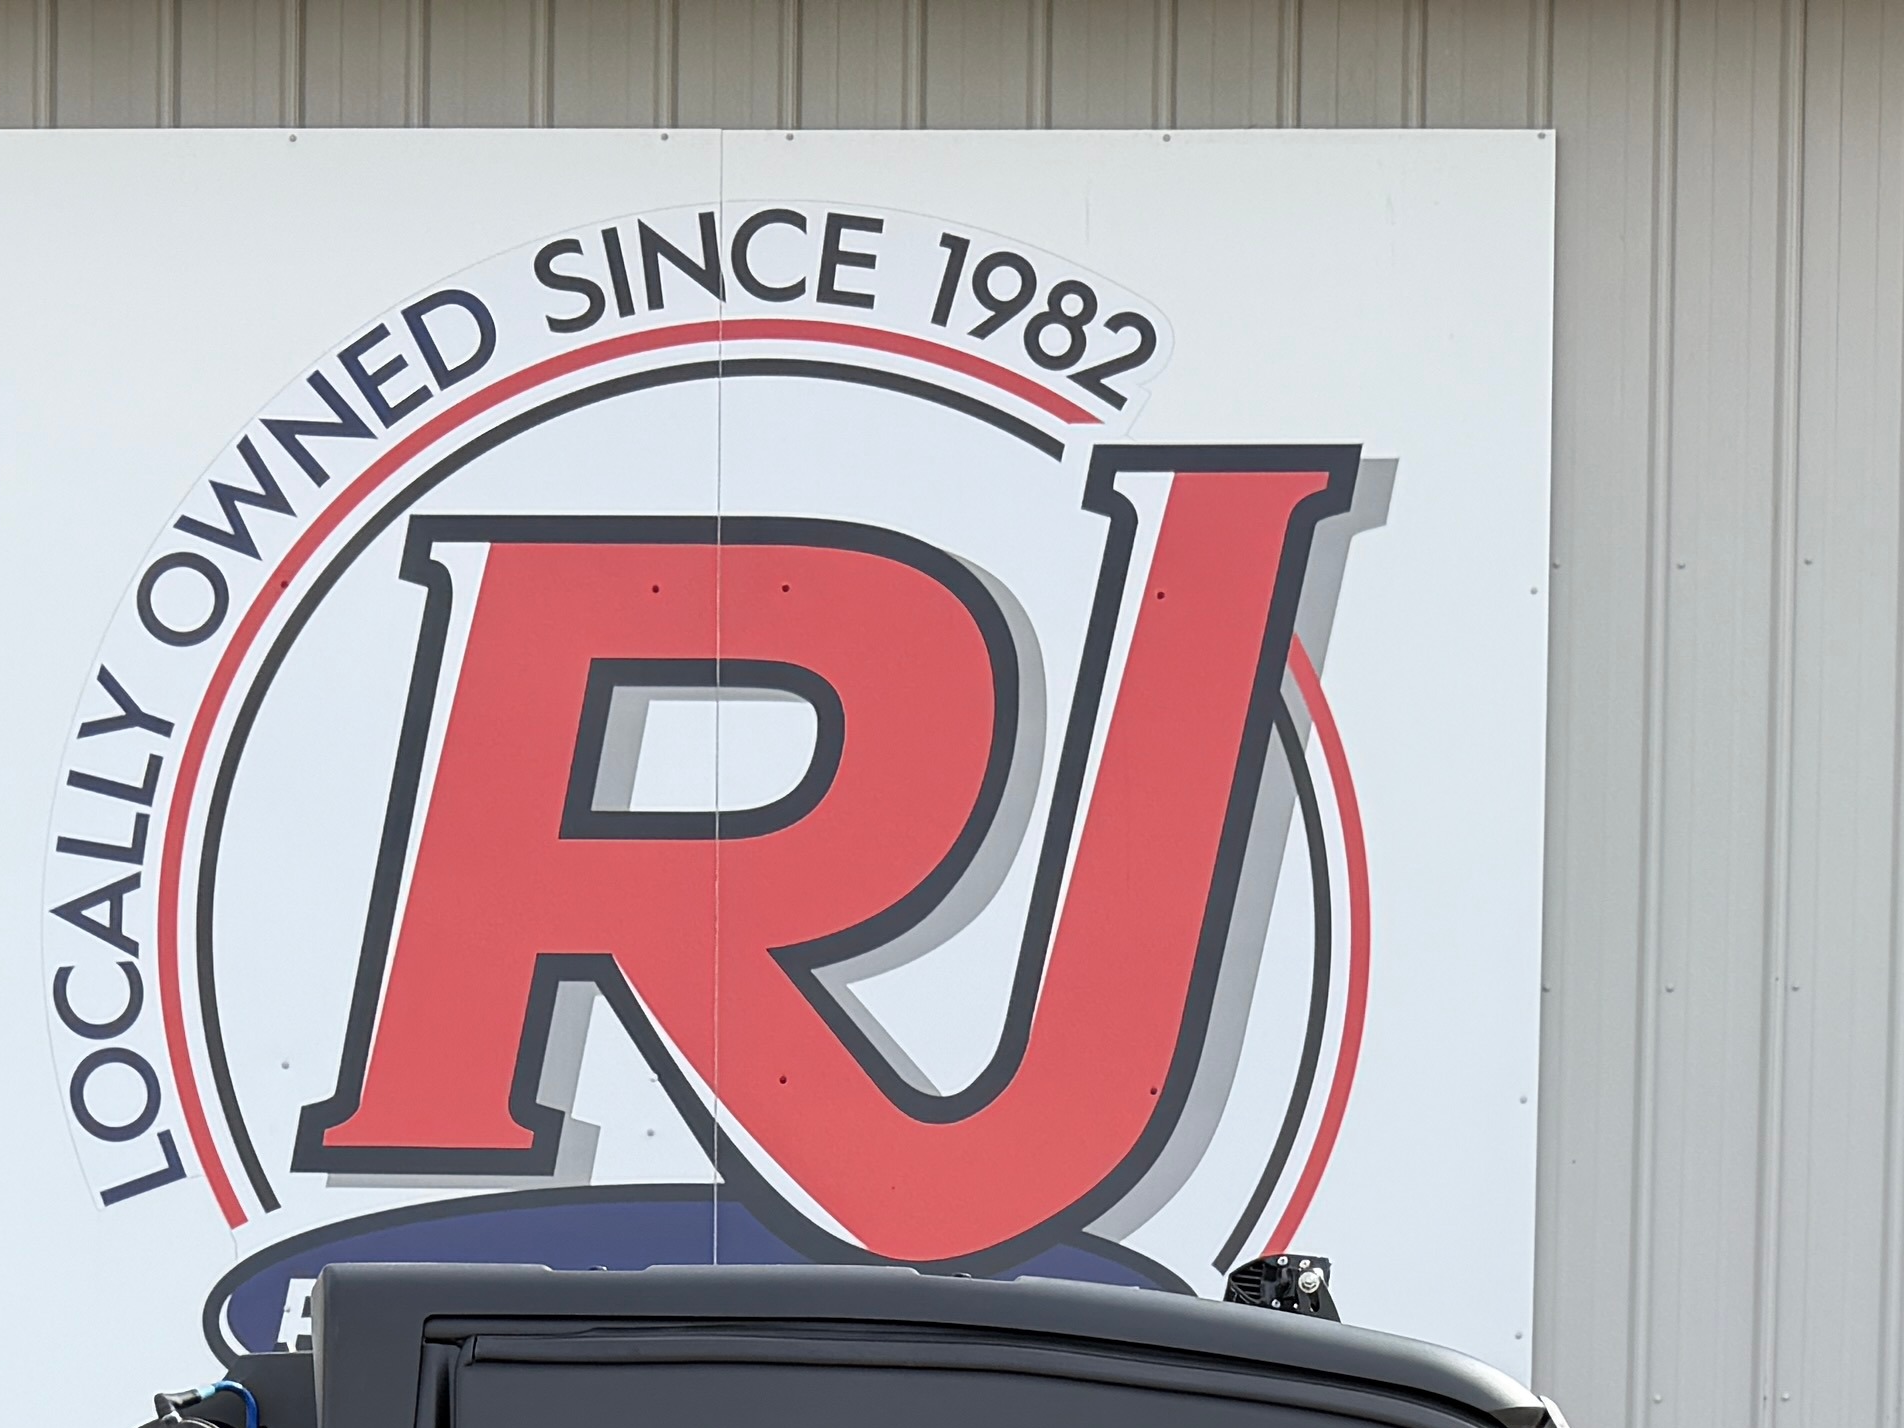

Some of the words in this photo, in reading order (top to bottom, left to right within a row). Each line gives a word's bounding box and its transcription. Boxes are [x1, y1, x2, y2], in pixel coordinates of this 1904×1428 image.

[49, 664, 187, 1208] LOCALLY
[136, 289, 497, 647] OWNED
[533, 208, 884, 334] SINCE
[931, 232, 1157, 411] 1982
[292, 443, 1363, 1262] RJ
